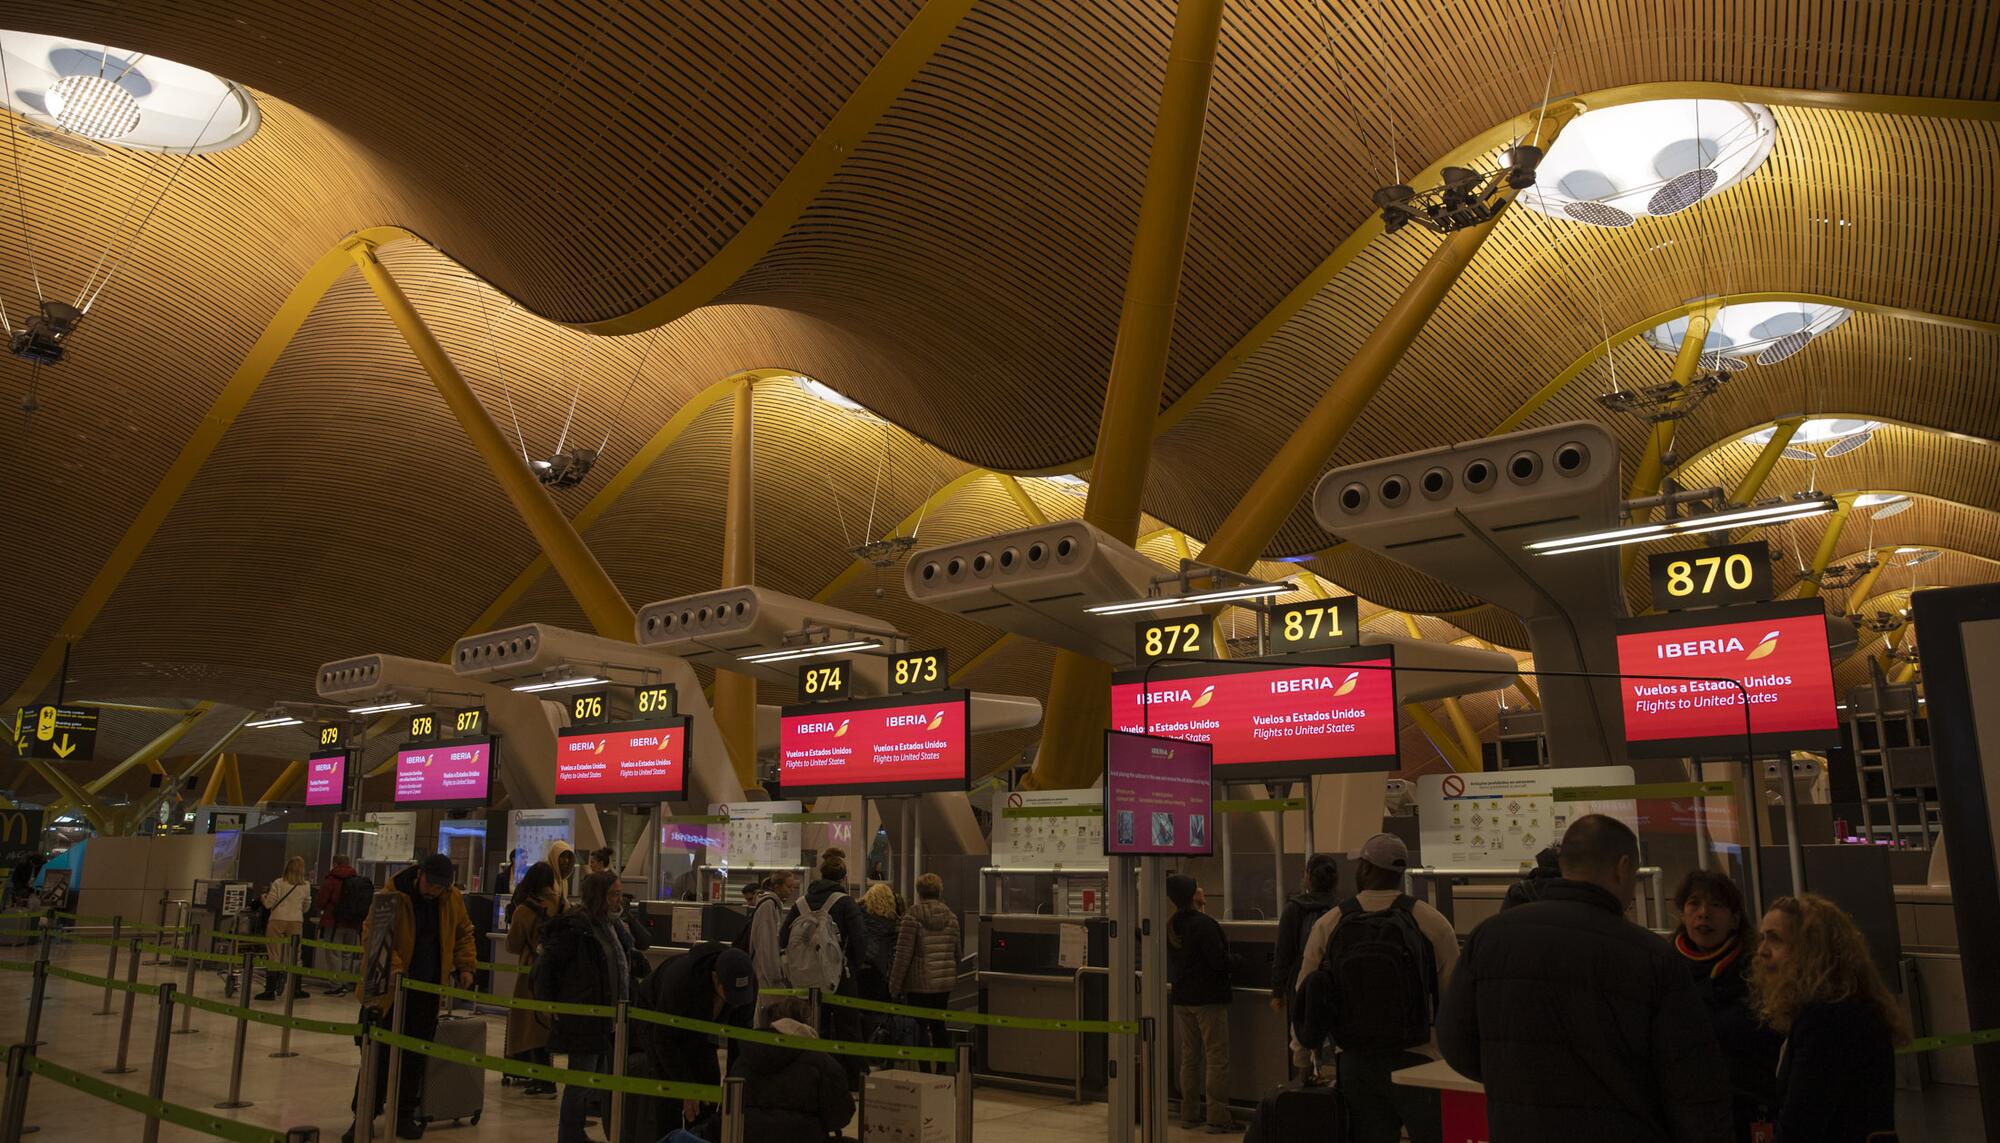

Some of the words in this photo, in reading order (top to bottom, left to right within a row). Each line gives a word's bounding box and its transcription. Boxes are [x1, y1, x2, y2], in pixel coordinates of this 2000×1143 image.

[1667, 553, 1753, 597] 870
[1284, 605, 1343, 641] 871
[1145, 623, 1200, 656] 872
[1657, 637, 1744, 659] IBERIA
[895, 656, 938, 685] 873
[805, 667, 841, 694] 874
[1271, 676, 1333, 693] IBERIA
[1634, 684, 1677, 696] Vuelos
[1680, 684, 1687, 693] a
[1744, 675, 1792, 688] Unidos
[639, 689, 667, 712] 875
[1136, 689, 1192, 705] IBERIA
[1636, 700, 1675, 714] Flights
[1678, 699, 1691, 709] to
[1694, 693, 1735, 708] United
[575, 697, 602, 719] 876
[1253, 714, 1284, 725] Vuelos
[1293, 711, 1330, 722] Estados
[1331, 708, 1366, 719] Unidos
[412, 717, 432, 736] 878
[457, 711, 480, 731] 877
[797, 722, 834, 734] IBERIA
[886, 714, 927, 727] IBERIA
[1155, 722, 1189, 733] Estados
[1190, 719, 1220, 730] Unidos
[321, 727, 338, 745] 879
[1253, 728, 1282, 740] Flights
[1284, 728, 1293, 736] to
[1295, 724, 1325, 735] United
[1326, 723, 1355, 733] States
[569, 742, 595, 752] IBERIA
[630, 737, 659, 747] IBERIA
[900, 742, 924, 751] Estados
[925, 740, 947, 749] Unidos
[406, 755, 426, 764] IBERIA
[450, 752, 472, 761] IBERIA
[809, 748, 831, 757] Estados
[873, 755, 893, 764] Flights
[894, 754, 900, 762] to
[900, 753, 920, 761] United
[921, 752, 940, 760] States
[786, 760, 803, 769] Flights
[810, 759, 828, 767] United
[828, 758, 845, 766] States
